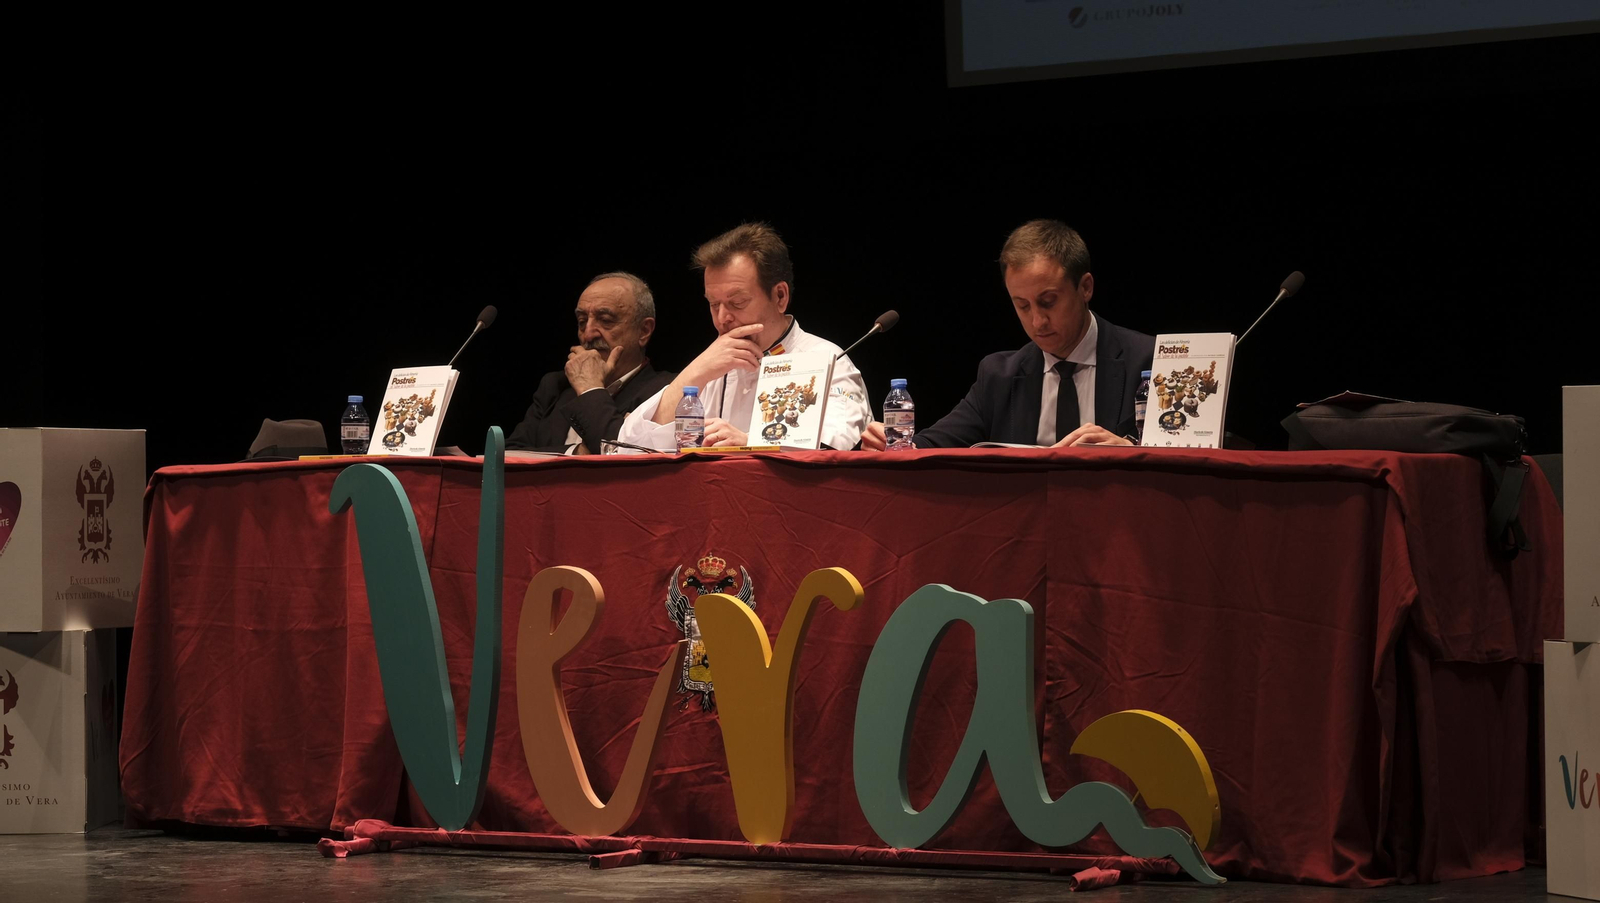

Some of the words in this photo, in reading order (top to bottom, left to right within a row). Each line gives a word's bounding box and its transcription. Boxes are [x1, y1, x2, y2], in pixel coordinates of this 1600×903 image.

[1158, 344, 1189, 354] Postres
[763, 364, 792, 374] Postres
[391, 376, 417, 385] Postres
[329, 425, 1227, 885] Vera
[6, 798, 21, 806] DE
[25, 795, 59, 806] VERA
